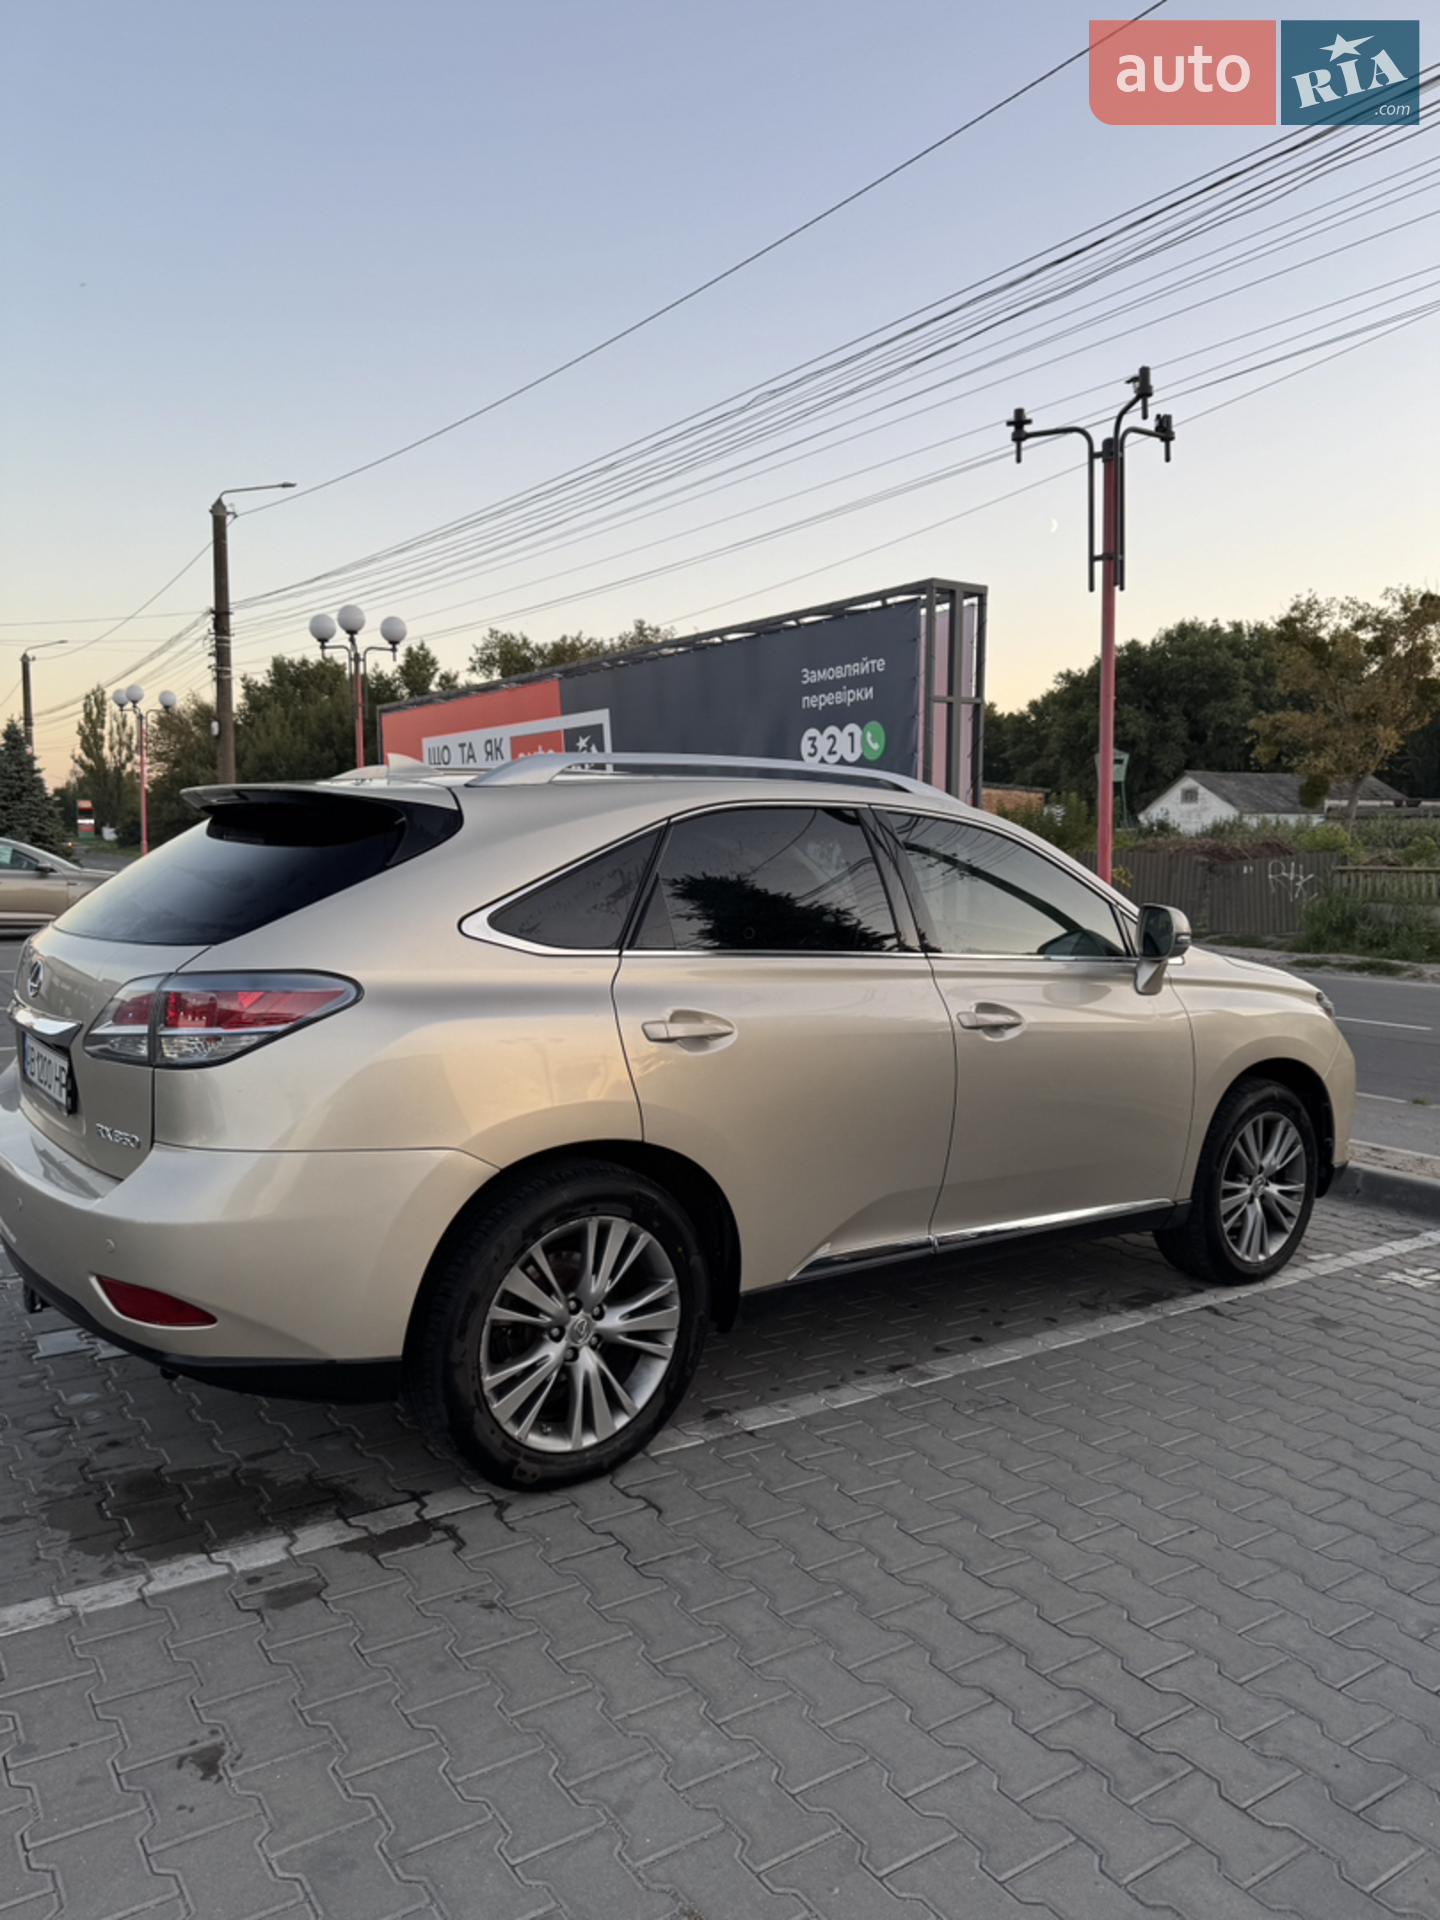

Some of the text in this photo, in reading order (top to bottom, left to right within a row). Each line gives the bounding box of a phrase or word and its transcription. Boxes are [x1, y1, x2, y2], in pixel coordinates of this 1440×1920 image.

[801, 656, 886, 685] Замовляйте
[802, 686, 874, 711] перевірки
[458, 741, 478, 764] ТА
[484, 737, 505, 762] ЯК
